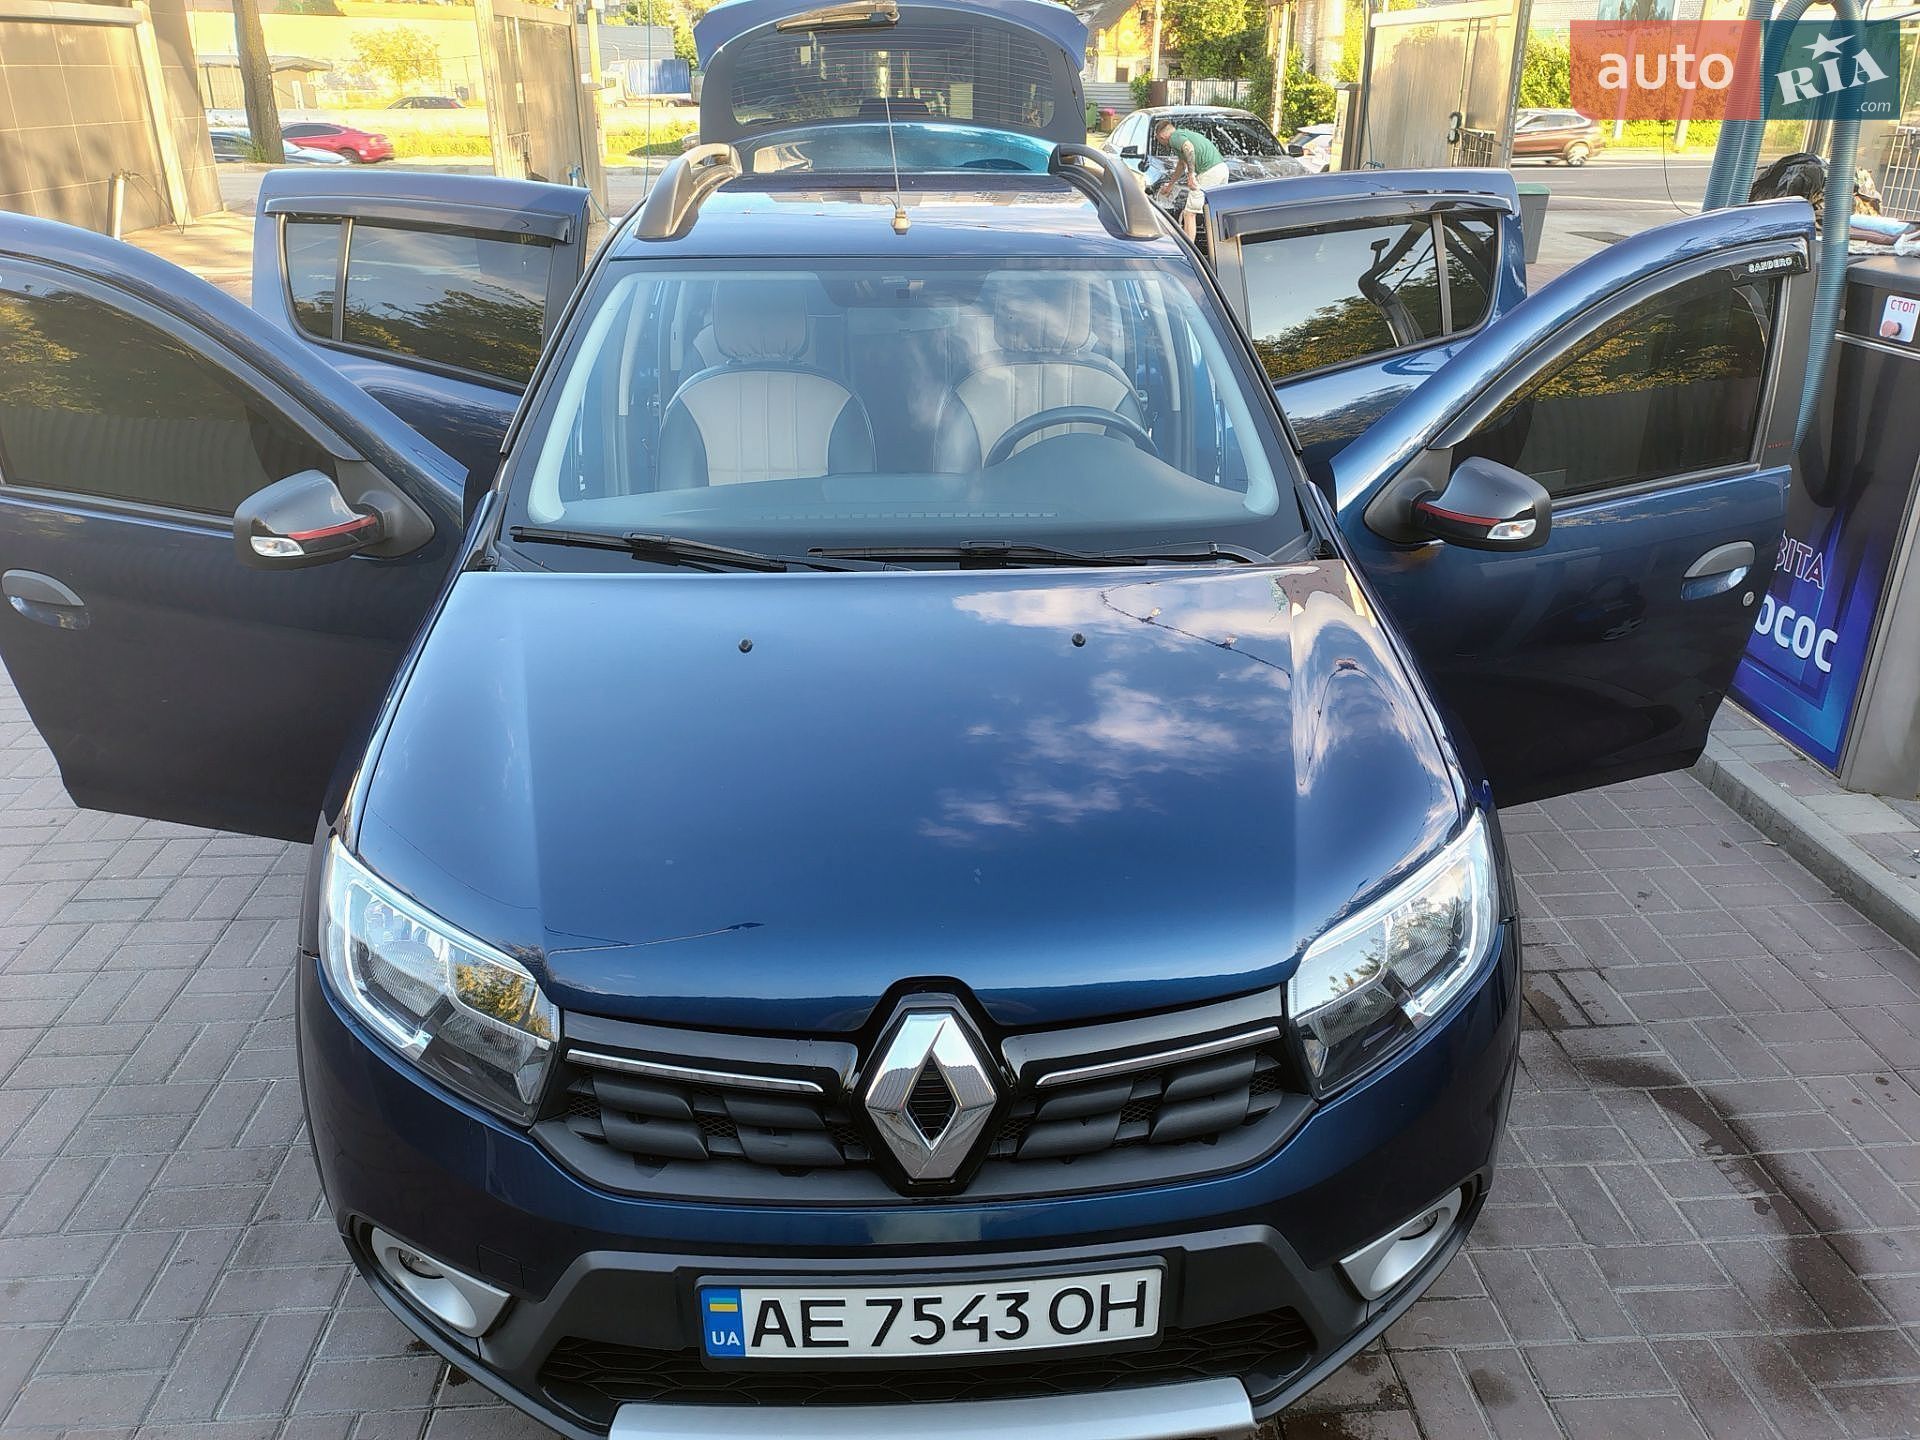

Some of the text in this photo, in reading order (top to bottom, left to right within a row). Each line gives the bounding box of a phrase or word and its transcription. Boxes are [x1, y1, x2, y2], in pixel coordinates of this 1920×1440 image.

[1748, 257, 1792, 273] SANDERO
[1890, 299, 1916, 313] СТОП
[750, 1280, 1147, 1348] AE 7543 OH
[711, 1331, 741, 1346] UA
